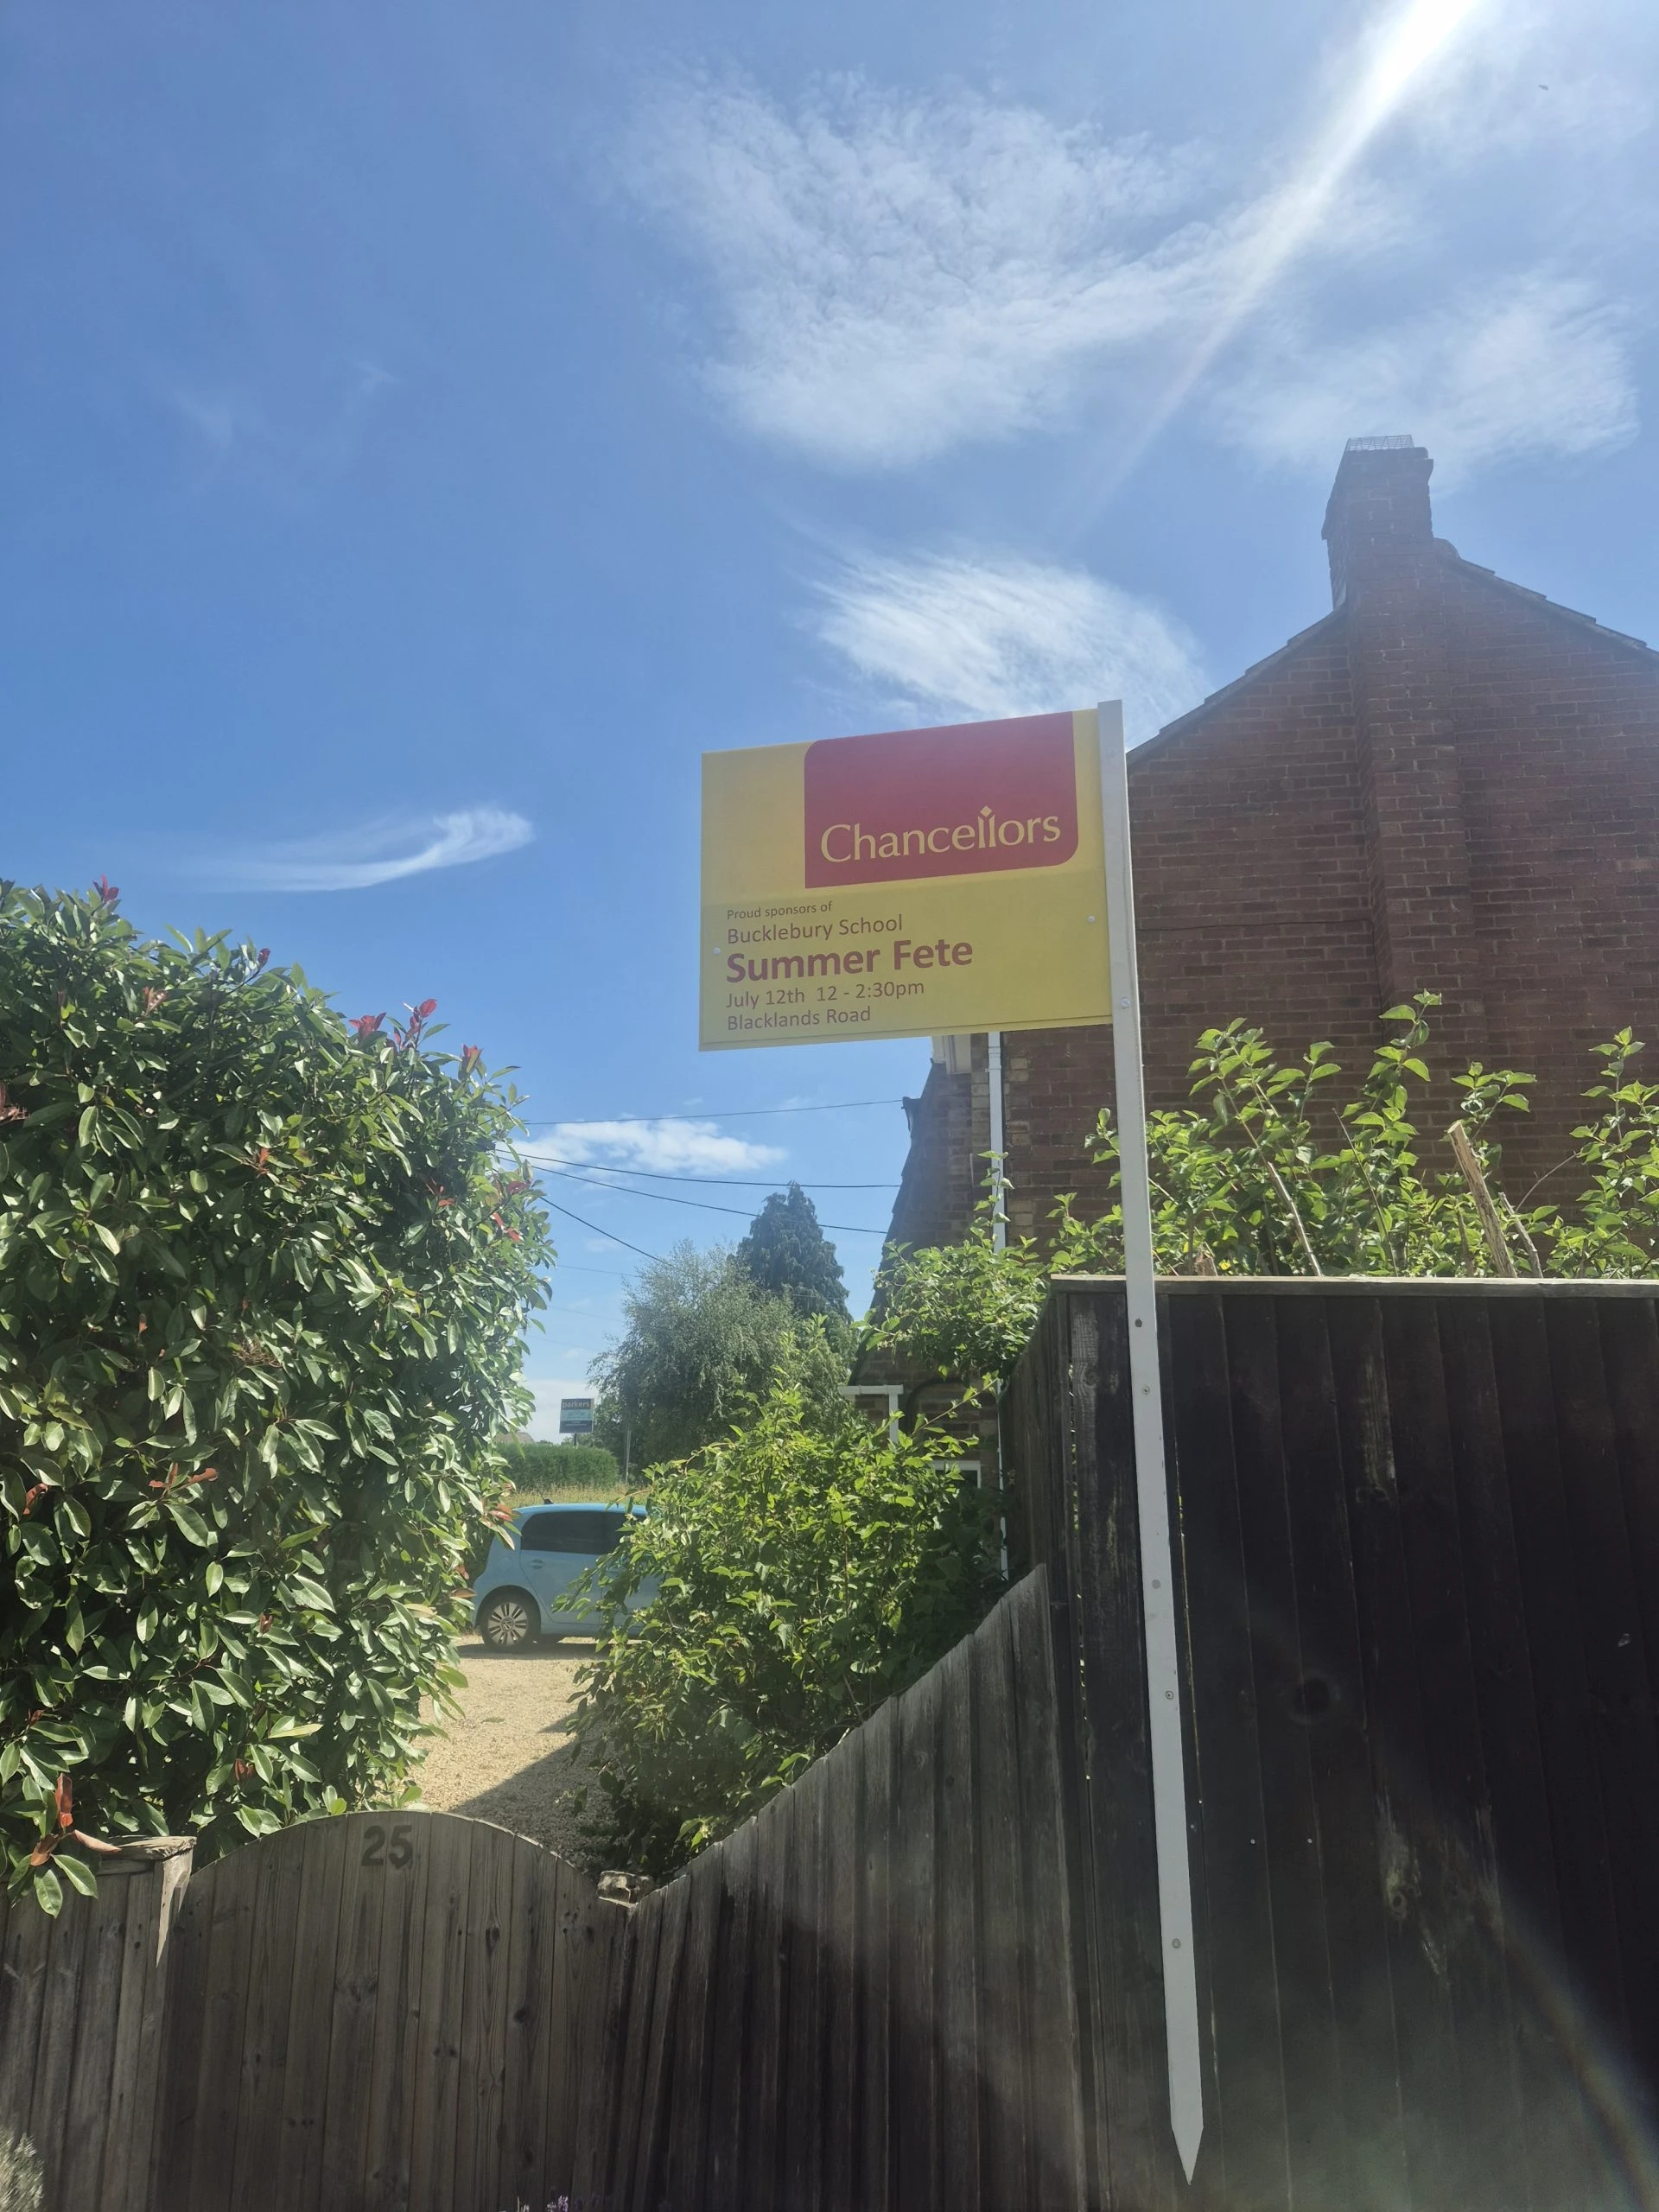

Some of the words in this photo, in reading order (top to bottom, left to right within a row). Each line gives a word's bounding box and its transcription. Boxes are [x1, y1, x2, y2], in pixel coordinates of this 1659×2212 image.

[820, 806, 1061, 863] Chancellors
[728, 907, 760, 919] Proud
[765, 904, 817, 918] sponsors
[820, 901, 833, 912] of
[728, 923, 833, 944] Bucklebury
[838, 913, 902, 935] School
[727, 950, 880, 982] Summer
[893, 939, 973, 970] Fete
[726, 991, 760, 1009] July
[766, 988, 804, 1005] 12th
[817, 985, 837, 1001] 12
[855, 982, 925, 999] 2:30pm
[728, 1009, 820, 1031] Blacklands
[827, 1006, 870, 1023] Road
[563, 1400, 589, 1409] parkers
[361, 1825, 413, 1870] 25
